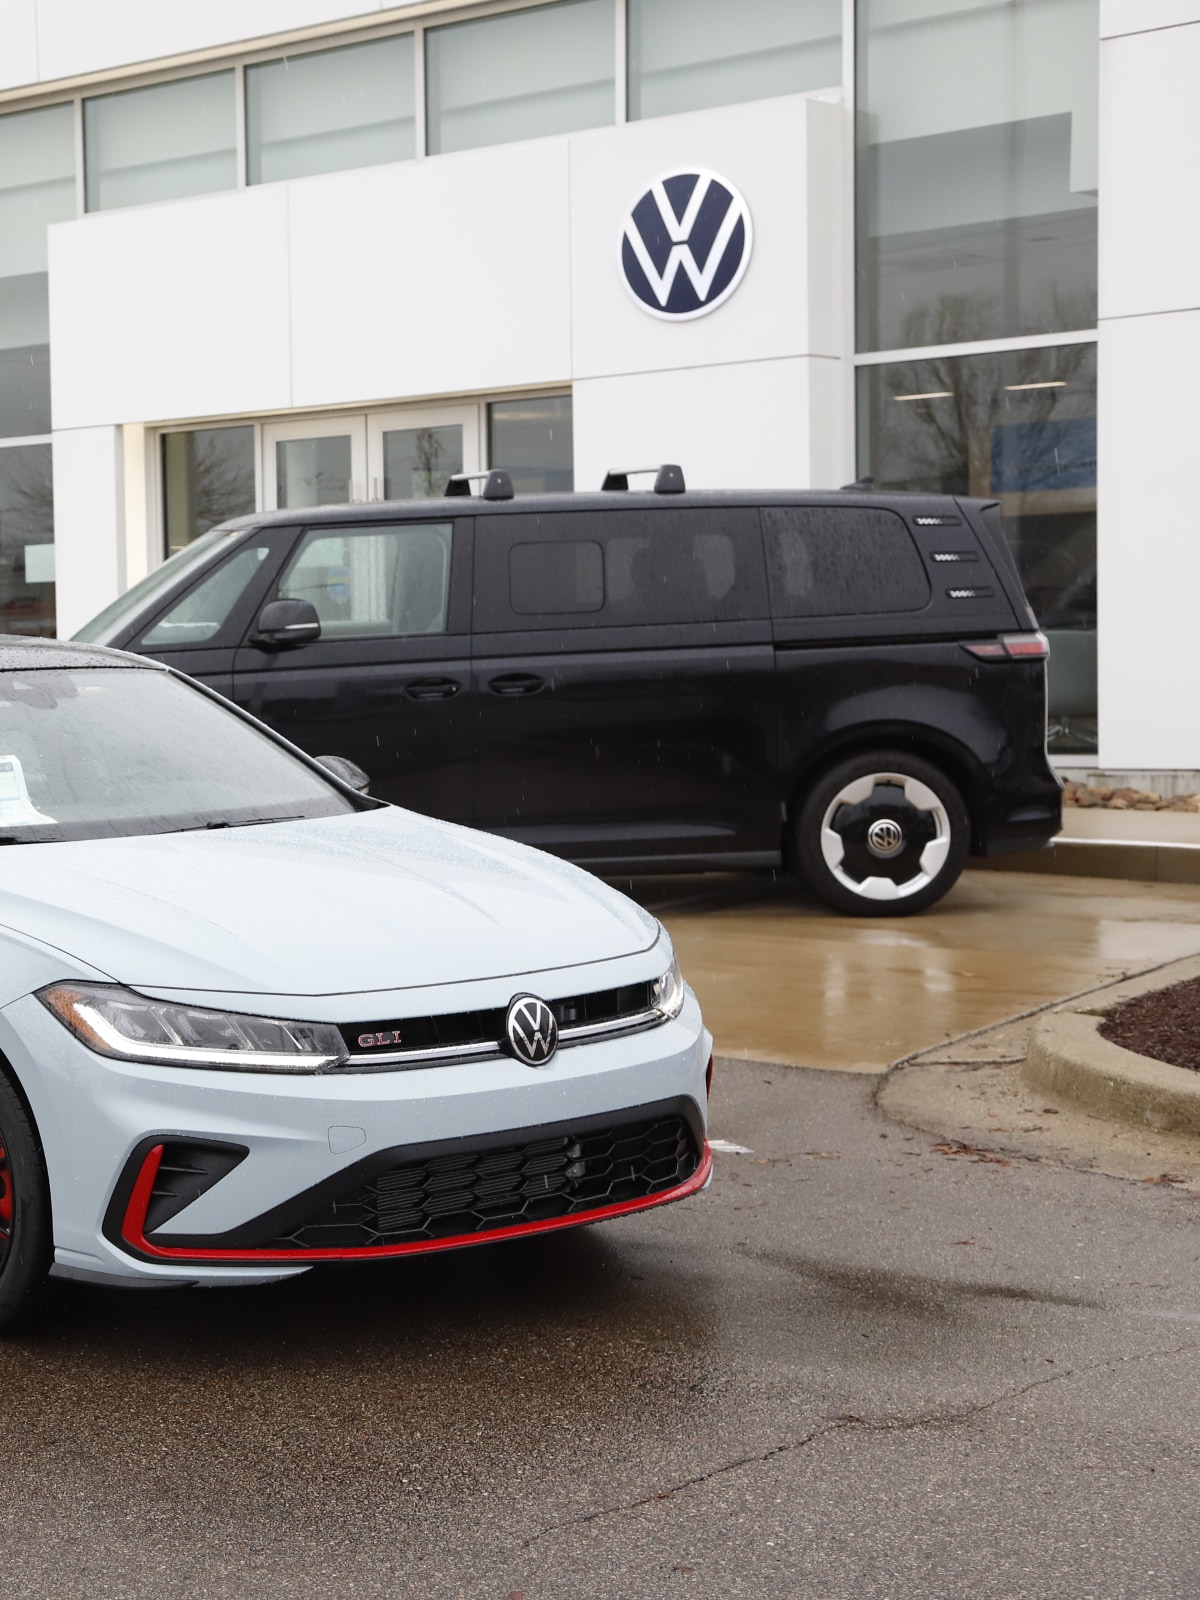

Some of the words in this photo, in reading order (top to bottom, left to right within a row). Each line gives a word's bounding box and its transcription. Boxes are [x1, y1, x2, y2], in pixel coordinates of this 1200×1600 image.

[620, 168, 752, 322] VW
[358, 1030, 402, 1048] GLI
[508, 996, 558, 1065] VW
